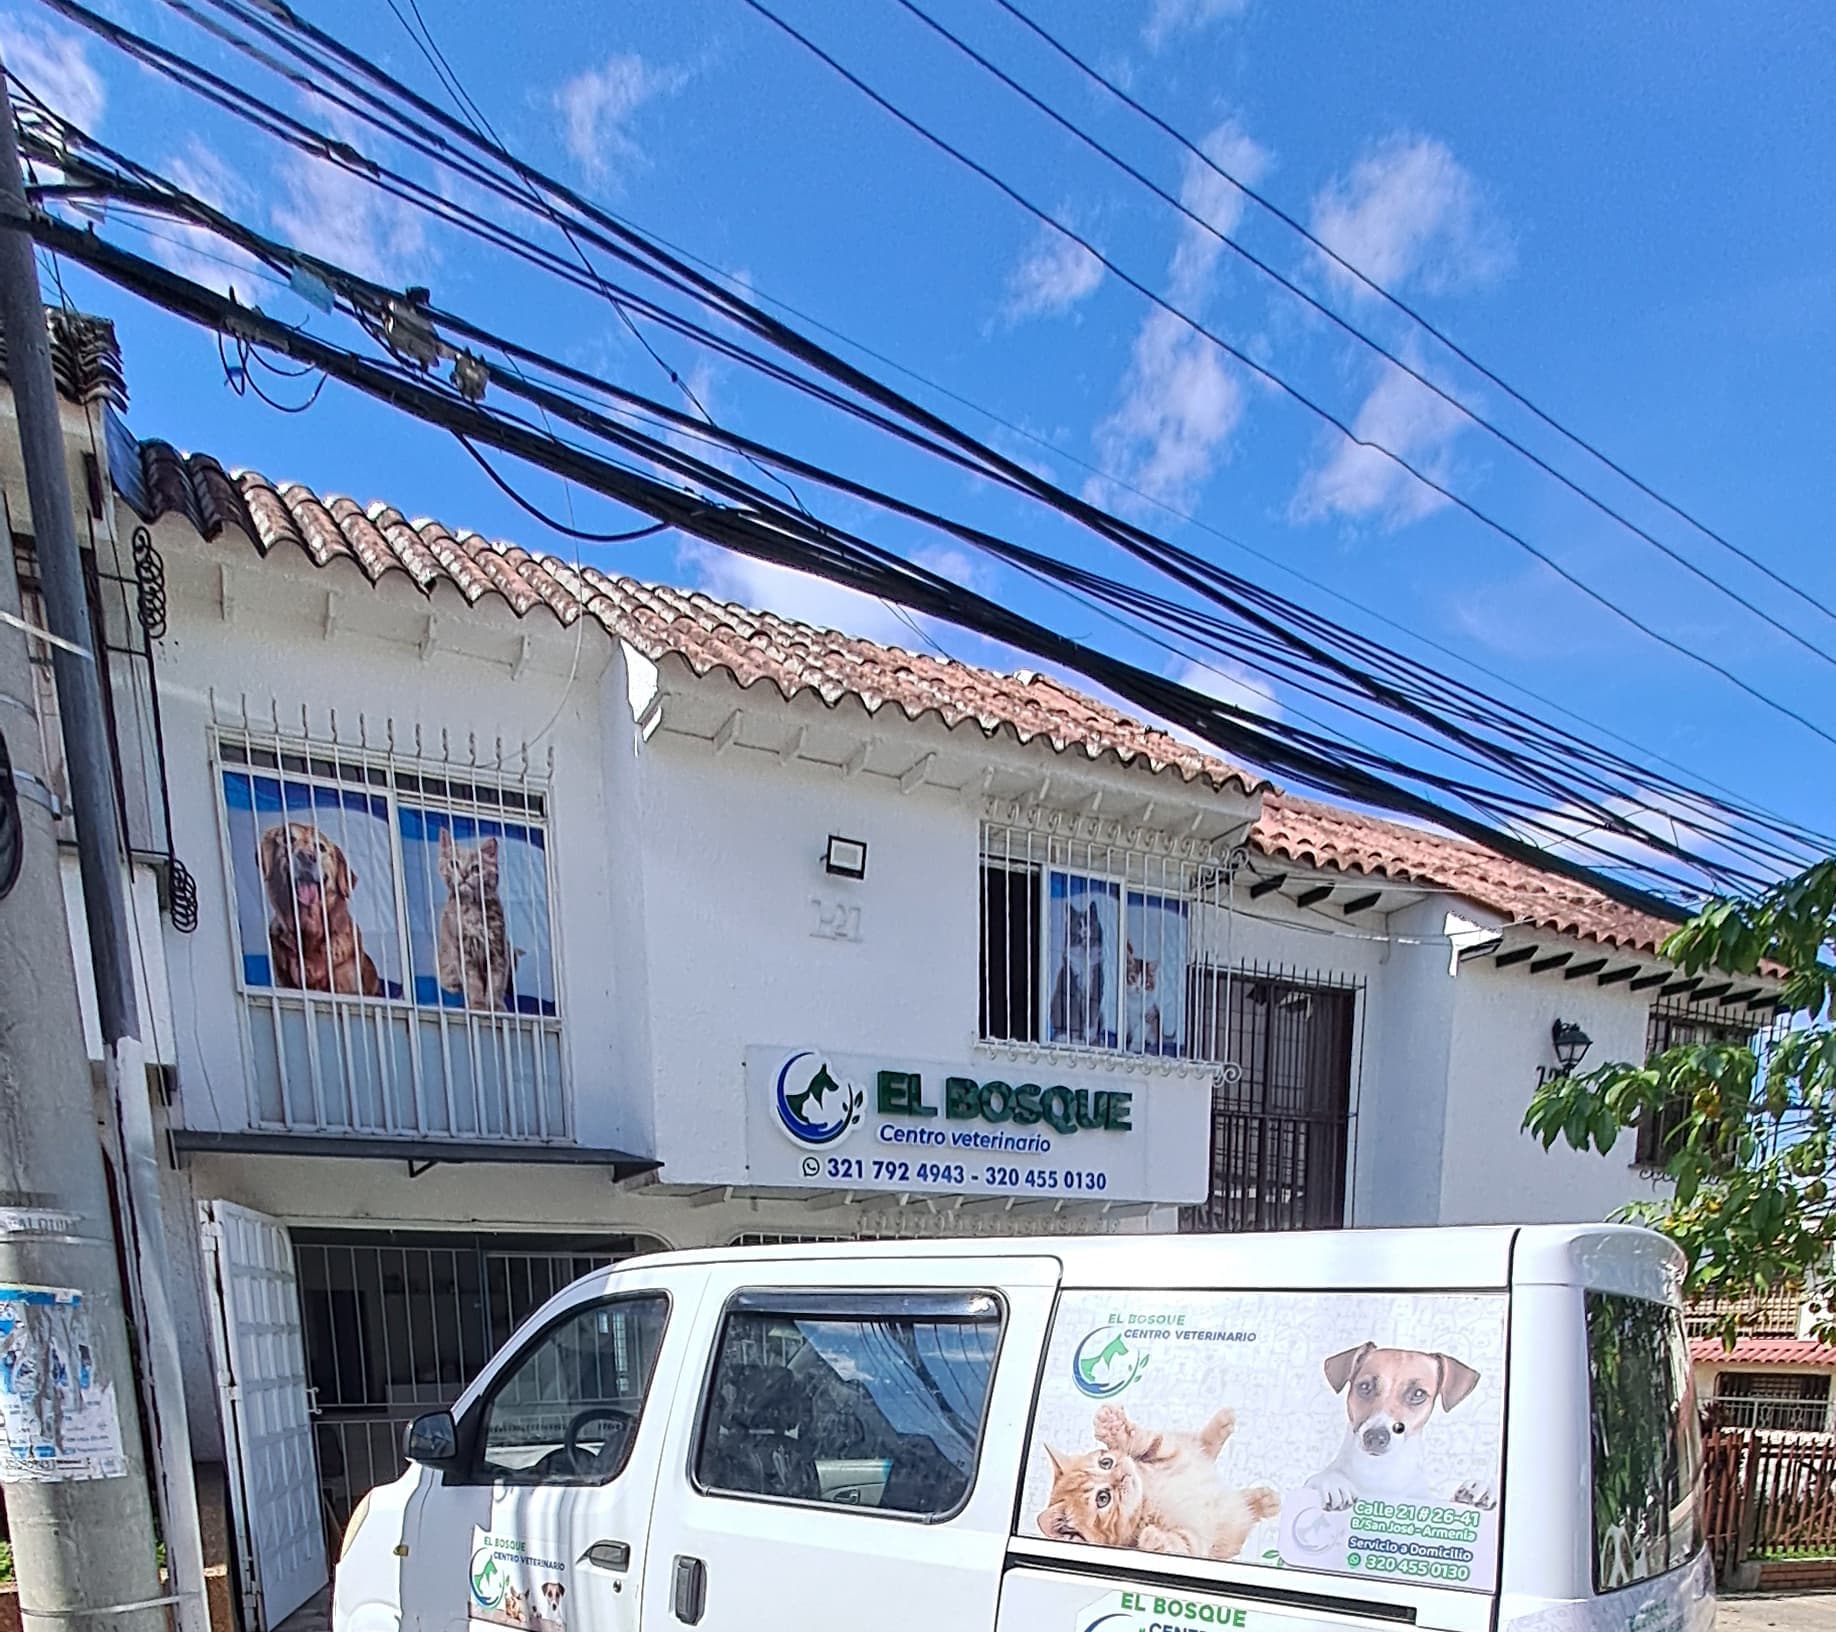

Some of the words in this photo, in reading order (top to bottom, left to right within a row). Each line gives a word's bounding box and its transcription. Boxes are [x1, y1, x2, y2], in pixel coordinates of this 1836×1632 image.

[877, 1070, 938, 1117] EL
[946, 1077, 1132, 1134] BOSQUE
[880, 1124, 945, 1146] Centro
[951, 1131, 1051, 1153] veterinario
[828, 1157, 863, 1179] 321
[872, 1160, 909, 1181] 792
[917, 1163, 964, 1184] 4943
[986, 1167, 1019, 1186] 320
[1025, 1170, 1058, 1188] 455
[1064, 1171, 1107, 1190] 0130
[1108, 1313, 1124, 1325] EL
[1128, 1314, 1186, 1326] BOSQUE
[1124, 1329, 1171, 1340] CENTRO
[1175, 1330, 1257, 1342] VETERINARIO
[1354, 1500, 1395, 1518] Calle
[1396, 1504, 1416, 1521] 21
[1417, 1506, 1430, 1521] #
[1432, 1508, 1480, 1527] 26-41
[1351, 1518, 1386, 1533] B/San
[1387, 1522, 1415, 1535] José
[1422, 1526, 1477, 1542] Armenia
[484, 1536, 492, 1546] EL
[495, 1538, 526, 1551] BOSQUE
[1349, 1536, 1398, 1553] Servicio
[1400, 1543, 1409, 1554] a
[1410, 1543, 1473, 1562] Domicilio
[494, 1551, 519, 1563] CENTRO
[520, 1555, 565, 1571] VETERINARIO
[1365, 1554, 1396, 1571] 320
[1398, 1558, 1428, 1575] 455
[1430, 1563, 1470, 1580] 0130
[1121, 1592, 1146, 1612] EL
[1153, 1597, 1247, 1628] BOSQUE
